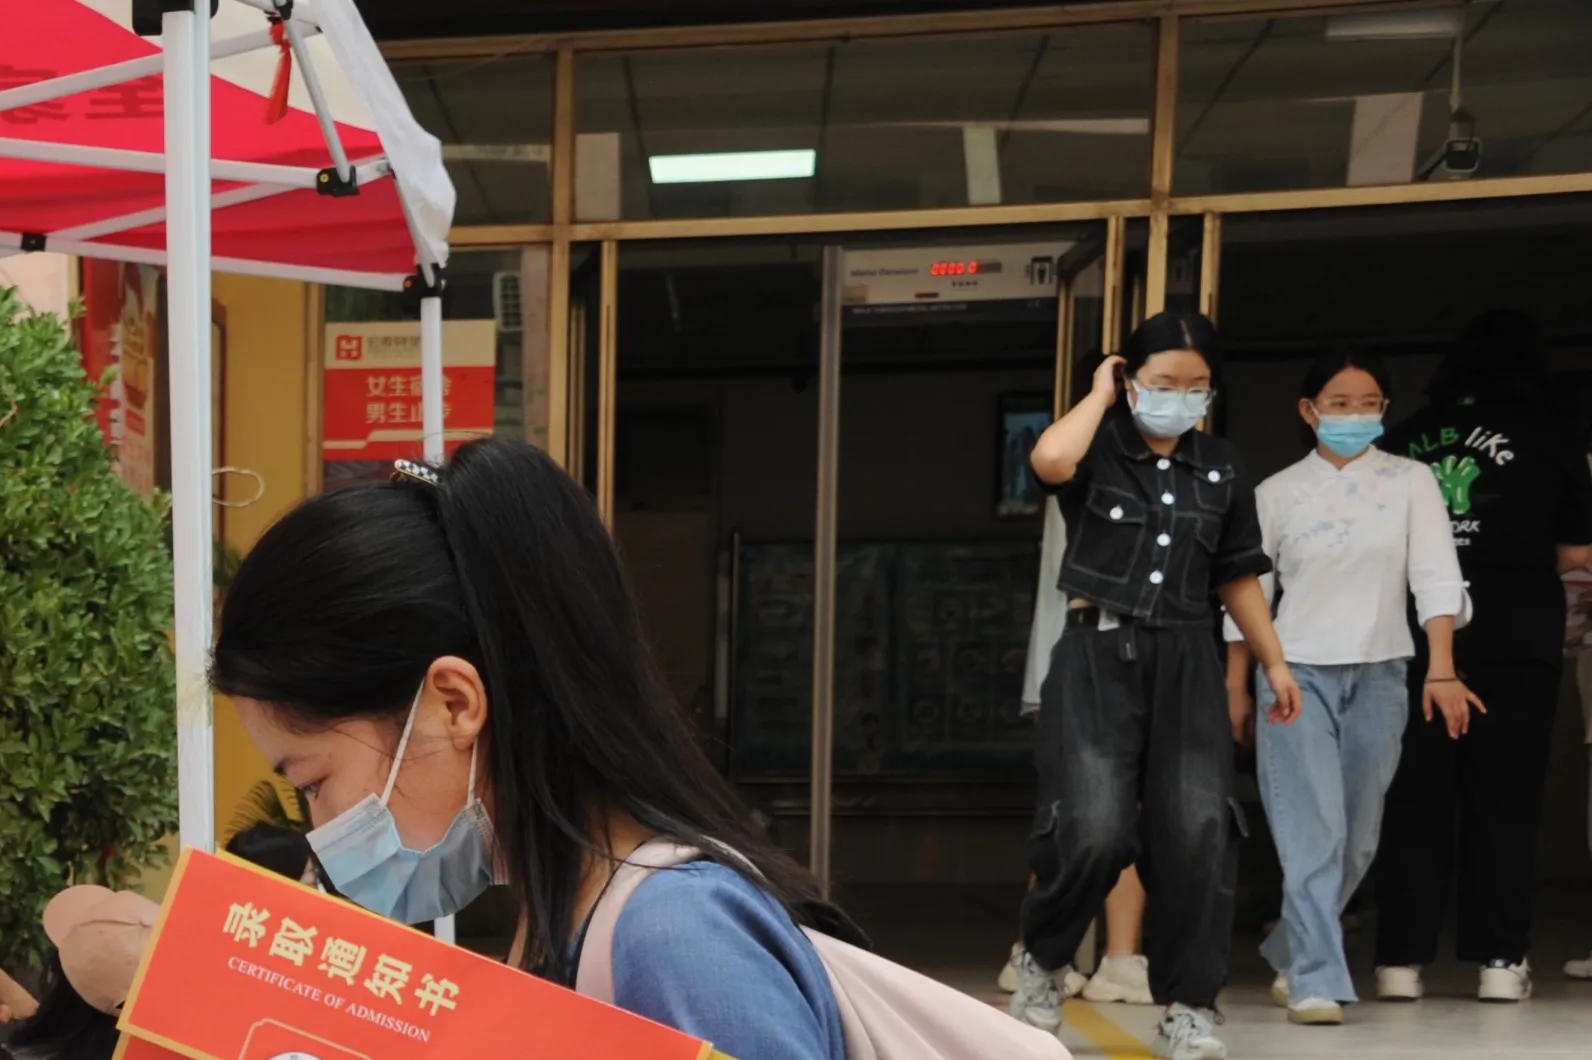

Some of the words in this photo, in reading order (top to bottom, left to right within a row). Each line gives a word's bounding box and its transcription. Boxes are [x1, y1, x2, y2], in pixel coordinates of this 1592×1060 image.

[222, 902, 460, 1017] 录取通知书
[228, 956, 322, 1002] CERTIFICATE
[324, 993, 346, 1009] OF
[346, 1002, 431, 1043] ADMISSION
